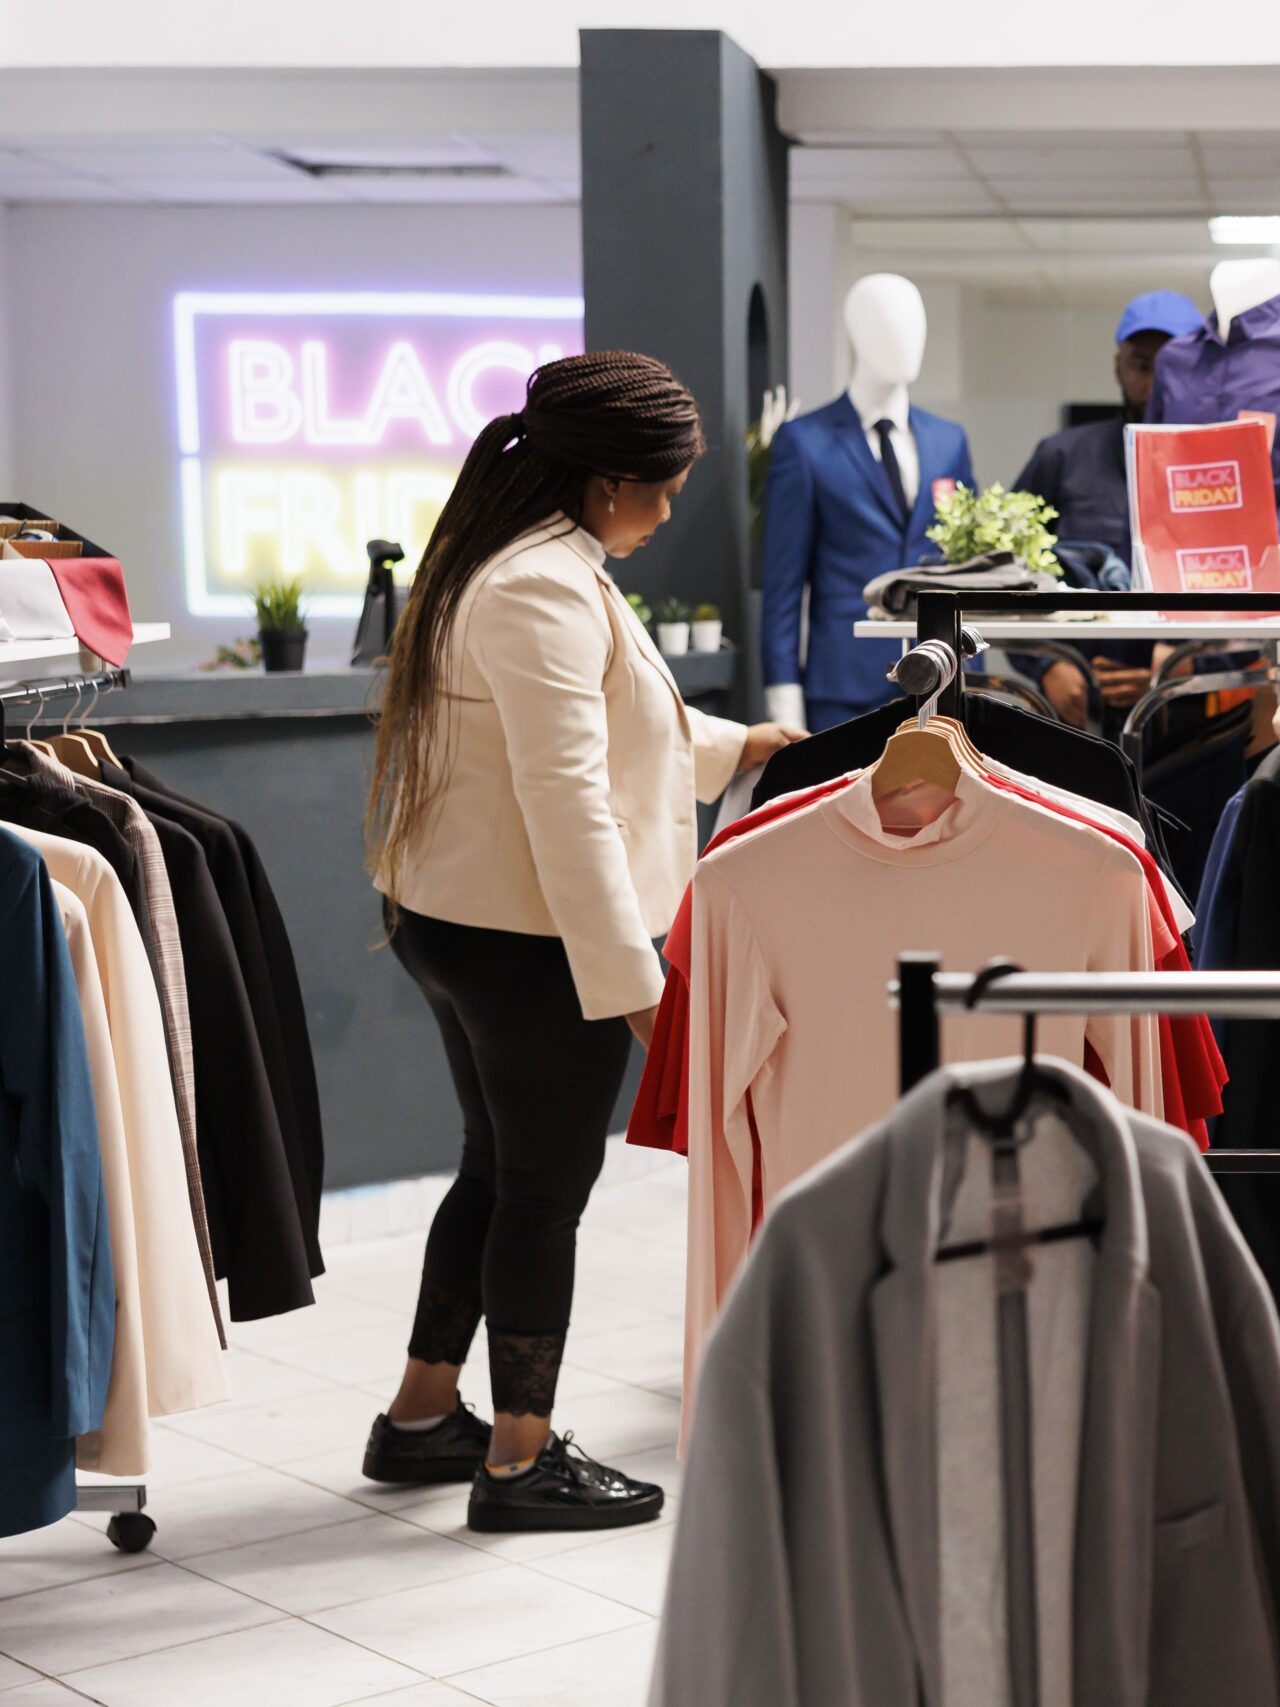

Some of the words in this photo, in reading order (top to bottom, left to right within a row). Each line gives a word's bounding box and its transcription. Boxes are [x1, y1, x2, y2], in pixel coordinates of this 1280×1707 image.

[227, 339, 563, 446] BLAC
[1174, 468, 1233, 488] BLACK
[1175, 486, 1236, 506] FRIDAY
[217, 470, 458, 577] FRID
[1183, 552, 1244, 570] BLACK
[1184, 570, 1246, 588] FRIDAY
